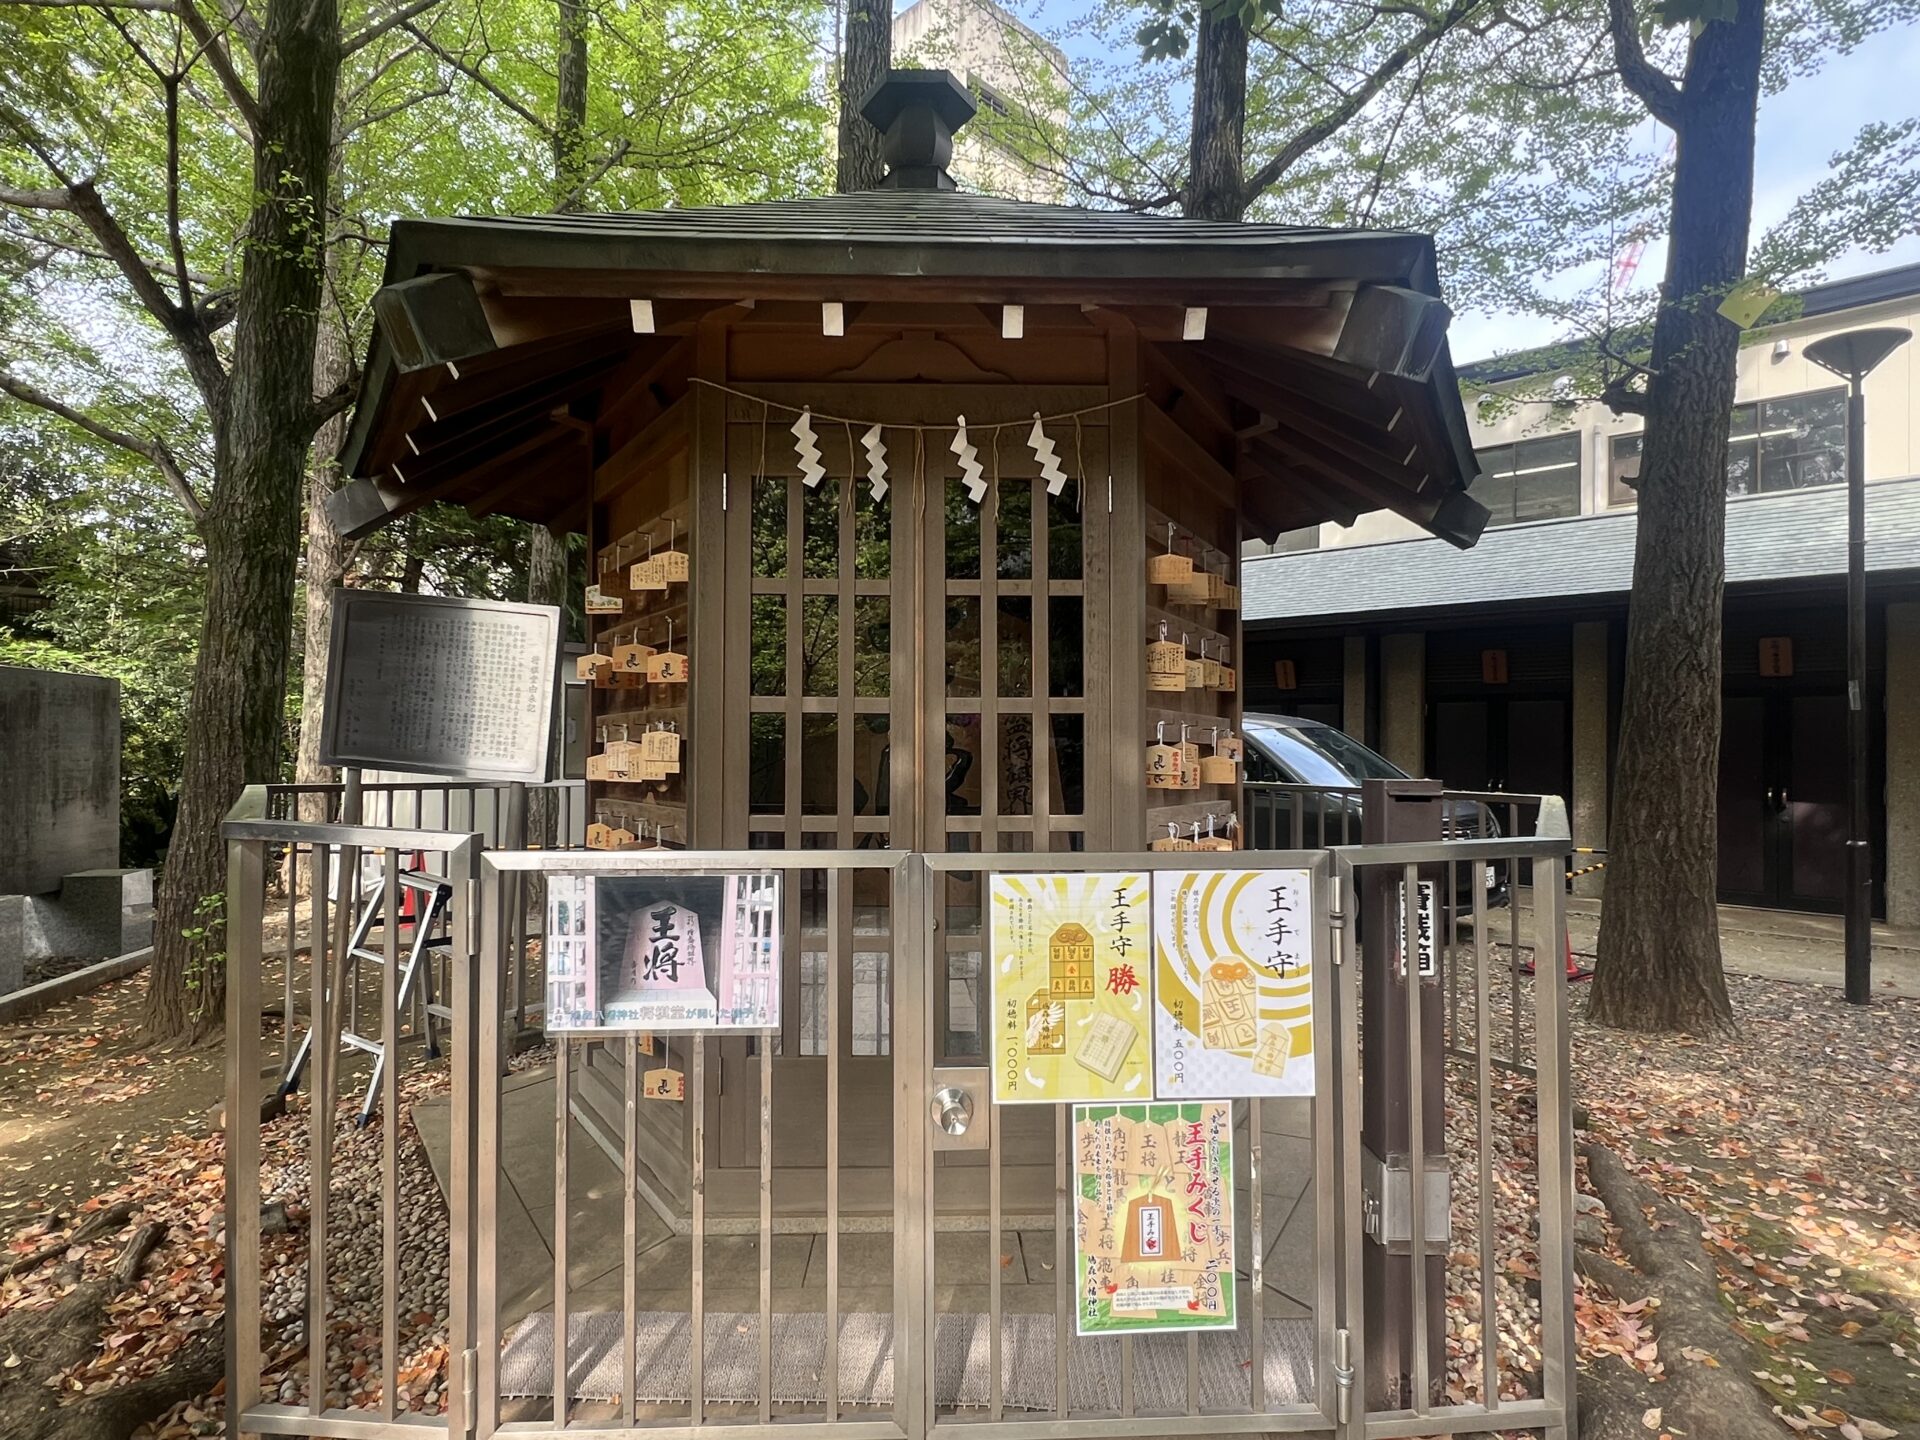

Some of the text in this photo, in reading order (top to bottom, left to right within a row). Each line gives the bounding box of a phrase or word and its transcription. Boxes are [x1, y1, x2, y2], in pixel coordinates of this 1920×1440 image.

[643, 906, 685, 982] 王将
[1110, 888, 1132, 957] 王手守
[1264, 886, 1295, 979] 王手守
[1105, 963, 1140, 996] 勝
[1006, 999, 1017, 1030] 初穂料
[1173, 1000, 1183, 1031] 初穂料
[1113, 1127, 1128, 1162] 角行
[1140, 1134, 1157, 1168] 玉将
[1186, 1123, 1207, 1244] 王手みくじ
[1088, 1255, 1098, 1317] 鳩森八幡神社
